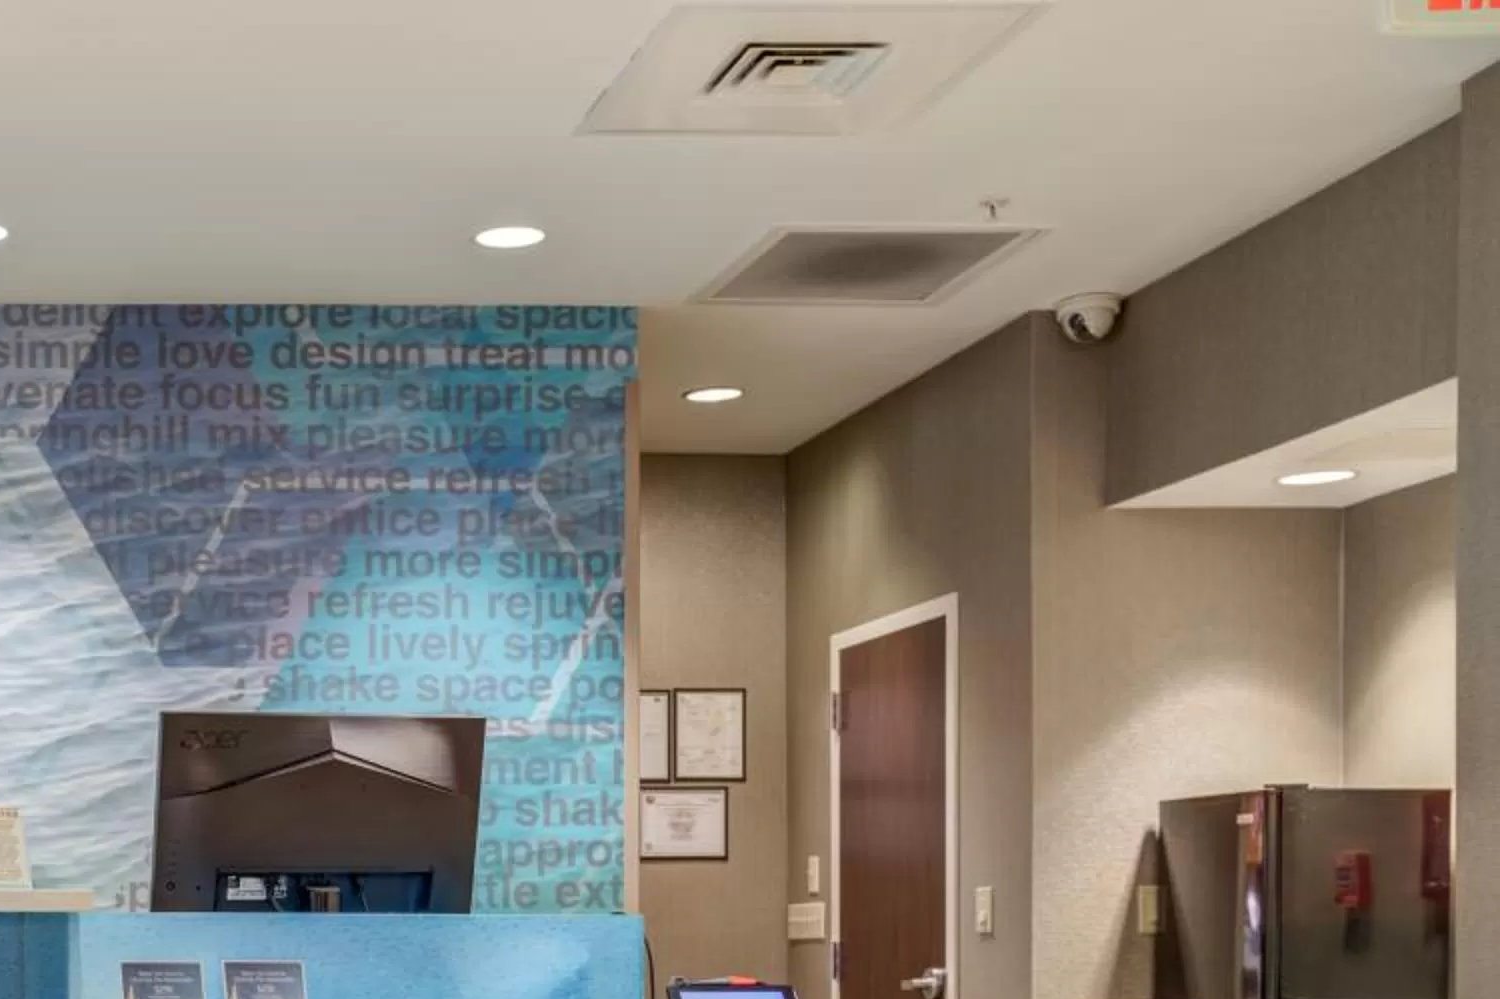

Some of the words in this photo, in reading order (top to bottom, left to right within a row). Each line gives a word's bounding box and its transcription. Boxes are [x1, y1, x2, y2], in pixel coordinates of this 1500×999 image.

[3, 303, 164, 336] delight
[179, 303, 354, 337] explore
[371, 304, 478, 329] local
[158, 334, 254, 369] love
[270, 334, 427, 381] design
[444, 338, 549, 371] treat
[161, 374, 289, 410] focus
[306, 376, 382, 411] fun
[401, 377, 589, 422] surprise
[209, 415, 289, 452] mix
[308, 418, 507, 464] pleasure
[525, 423, 625, 455] mor
[243, 457, 412, 494] service
[428, 458, 589, 494] refresh
[302, 502, 442, 537] entice
[149, 541, 348, 588] pleasure
[366, 550, 481, 579] more
[308, 583, 470, 619] refresh
[368, 624, 485, 671] lively
[264, 666, 400, 702] shake
[416, 674, 555, 713] space
